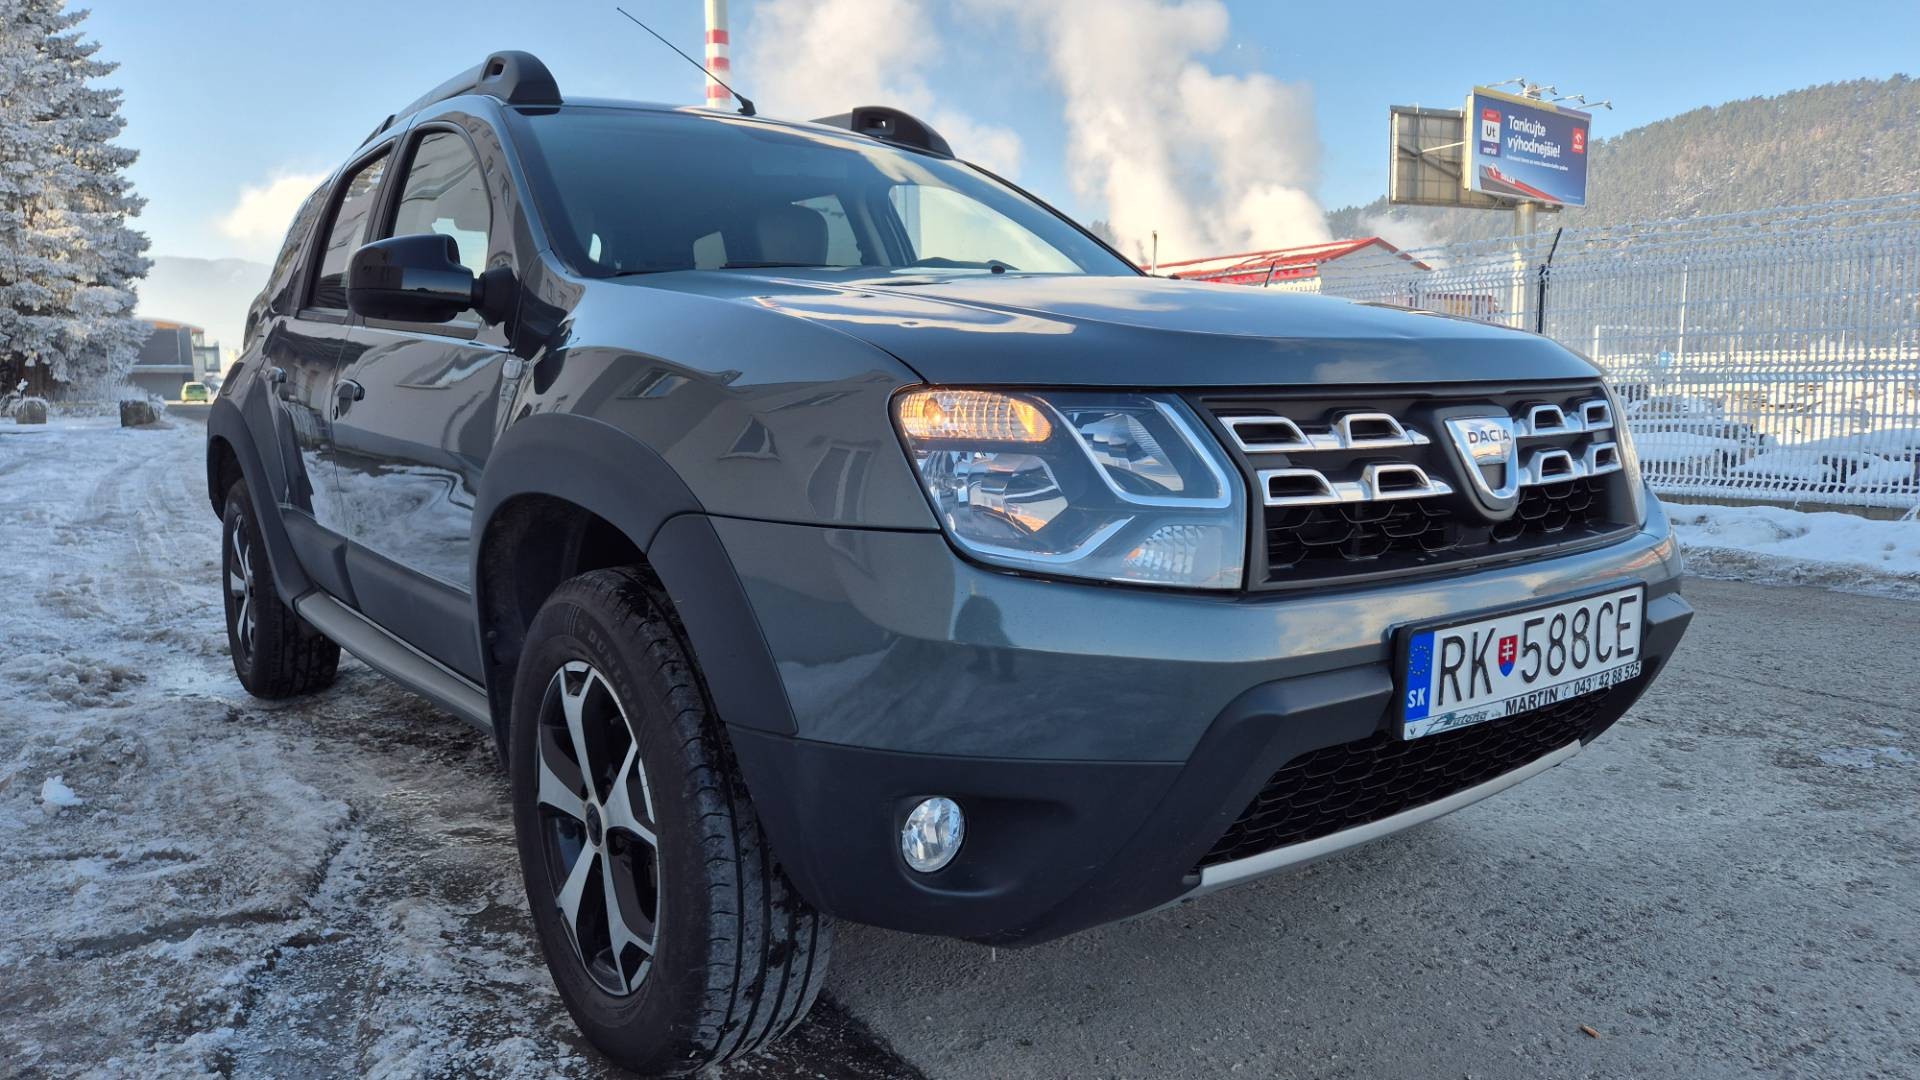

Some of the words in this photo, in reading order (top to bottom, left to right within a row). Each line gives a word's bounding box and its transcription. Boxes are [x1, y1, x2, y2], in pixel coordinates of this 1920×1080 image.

[1486, 125, 1496, 137] Ut
[1508, 114, 1546, 138] Tankujte
[1507, 134, 1561, 158] výhodnejšie!
[1467, 429, 1511, 444] DACIA
[1438, 627, 1496, 706] RK
[1521, 594, 1638, 684] 588CE
[587, 628, 640, 719] DUNLOP
[1407, 687, 1425, 709] SK
[1505, 687, 1559, 716] MARTIN
[1598, 671, 1610, 687] 42
[1612, 668, 1623, 684] 88
[1624, 662, 1640, 679] 525
